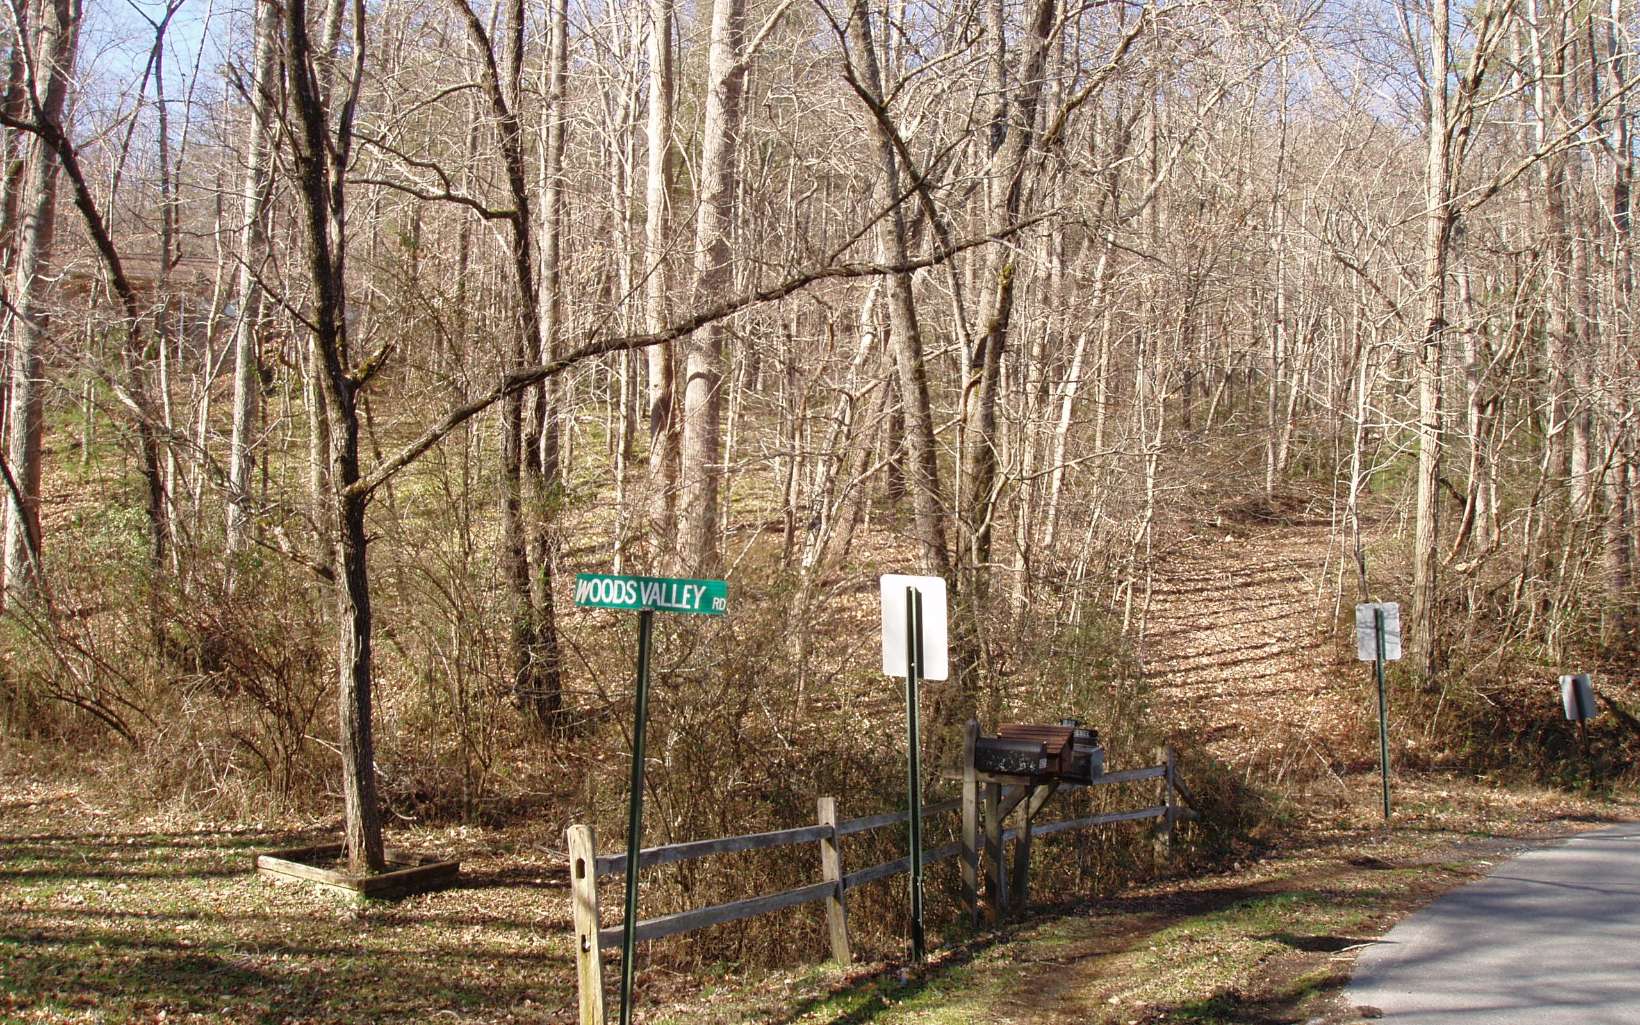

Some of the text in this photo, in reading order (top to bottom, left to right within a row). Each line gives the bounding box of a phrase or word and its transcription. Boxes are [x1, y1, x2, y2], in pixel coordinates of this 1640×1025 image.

[575, 578, 726, 611] WOODS VALLEY RD
